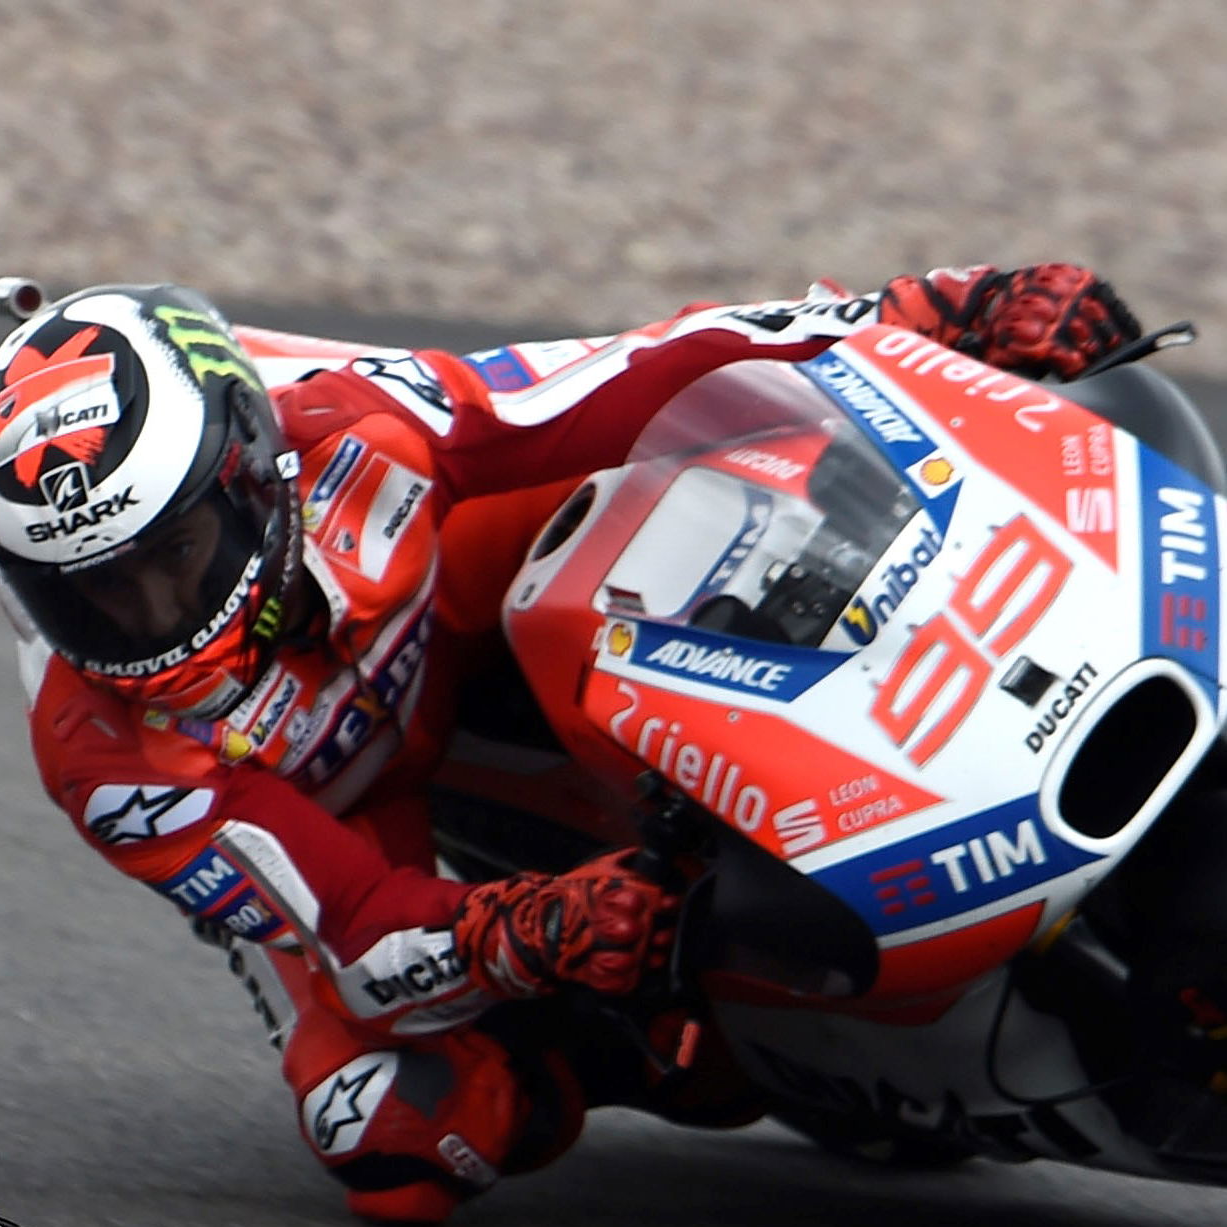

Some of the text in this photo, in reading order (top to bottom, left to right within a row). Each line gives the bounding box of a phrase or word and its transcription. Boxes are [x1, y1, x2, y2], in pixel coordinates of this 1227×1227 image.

[816, 358, 922, 443] ADVANCE
[1061, 433, 1085, 477] LEON
[1087, 423, 1114, 476] CUPRA
[25, 484, 140, 543] SHARK
[1158, 487, 1207, 585] TIM
[840, 526, 942, 647] Unibat
[646, 640, 792, 692] ADVANCE
[868, 512, 1075, 770] 99
[1024, 661, 1099, 754] DUCATI
[828, 773, 879, 806] LEON
[837, 794, 904, 832] CUPRA
[171, 855, 236, 905] TIM
[930, 818, 1047, 894] TIM
